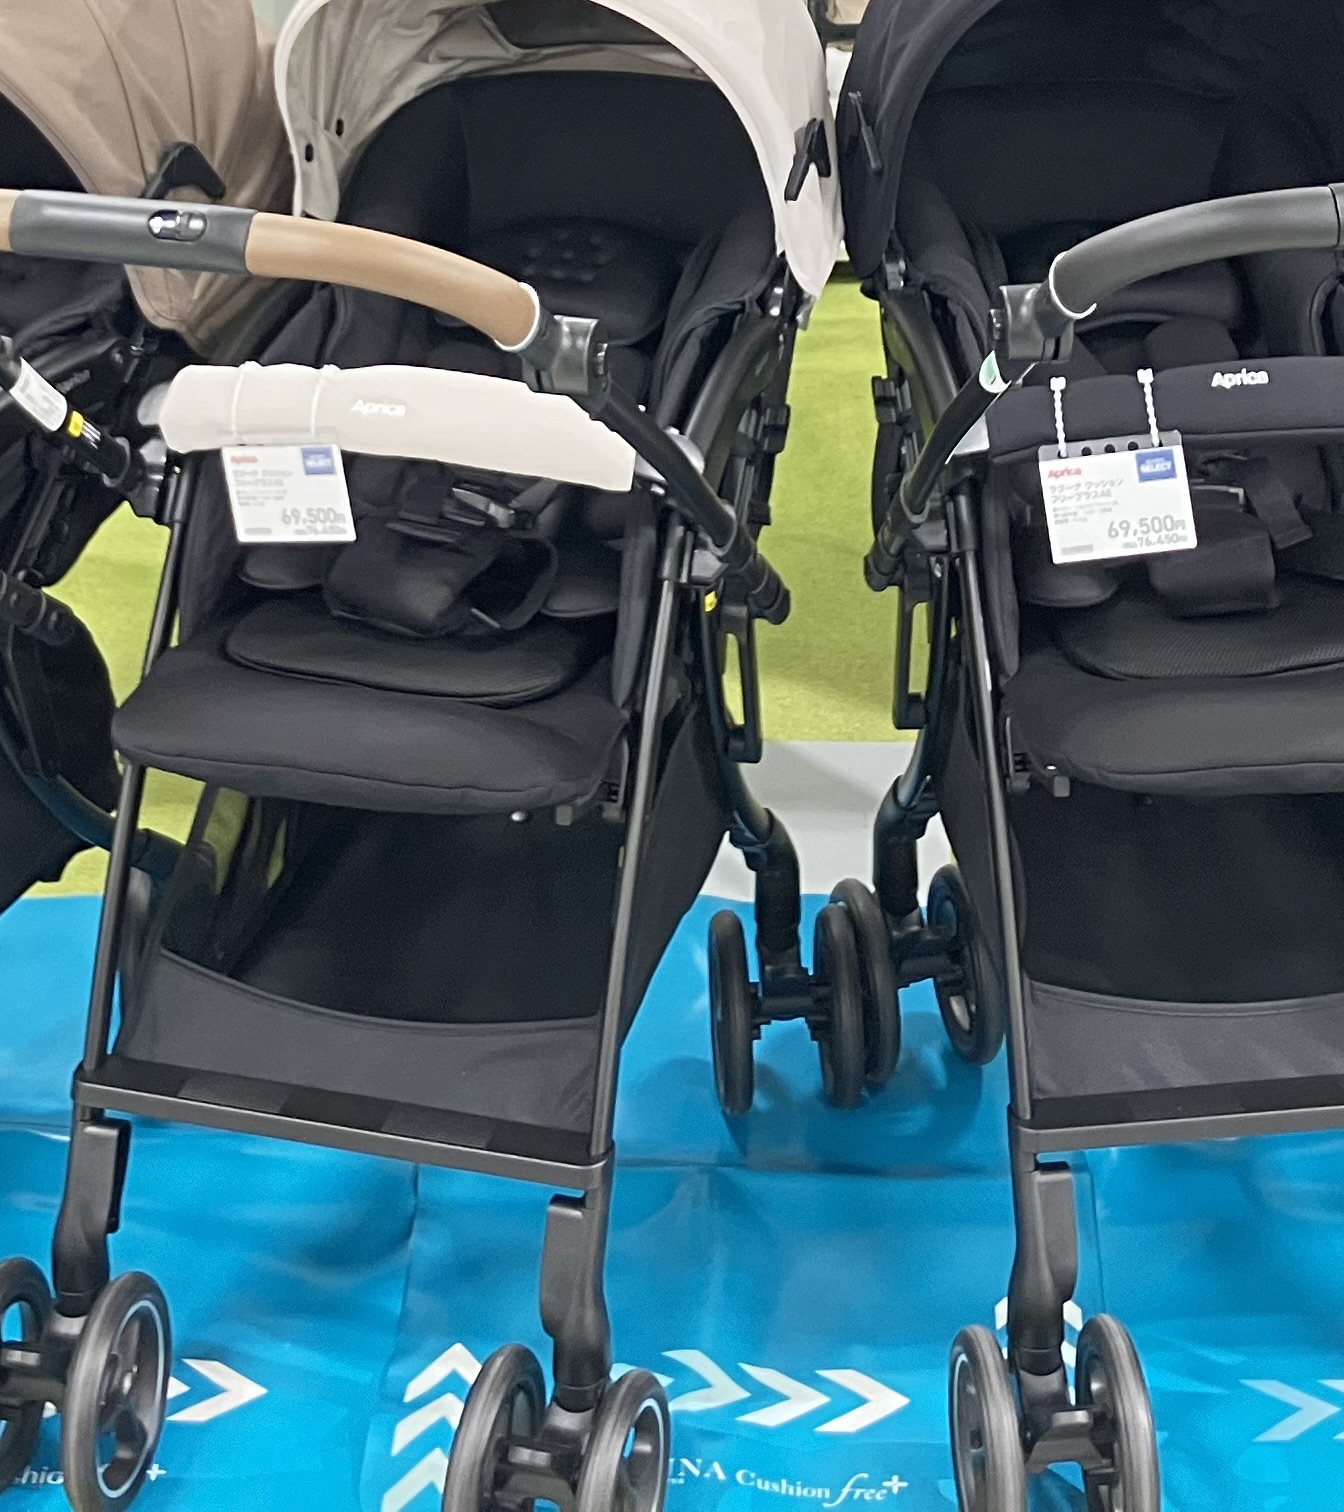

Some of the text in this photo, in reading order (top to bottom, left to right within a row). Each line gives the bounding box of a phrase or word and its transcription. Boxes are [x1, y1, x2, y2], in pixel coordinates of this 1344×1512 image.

[1211, 368, 1269, 389] Aprica
[350, 399, 406, 417] Aprica
[1048, 466, 1082, 479] Aprica
[1139, 461, 1172, 474] SELECT
[1108, 515, 1186, 538] 69,500円
[735, 1469, 831, 1500] Cushion
